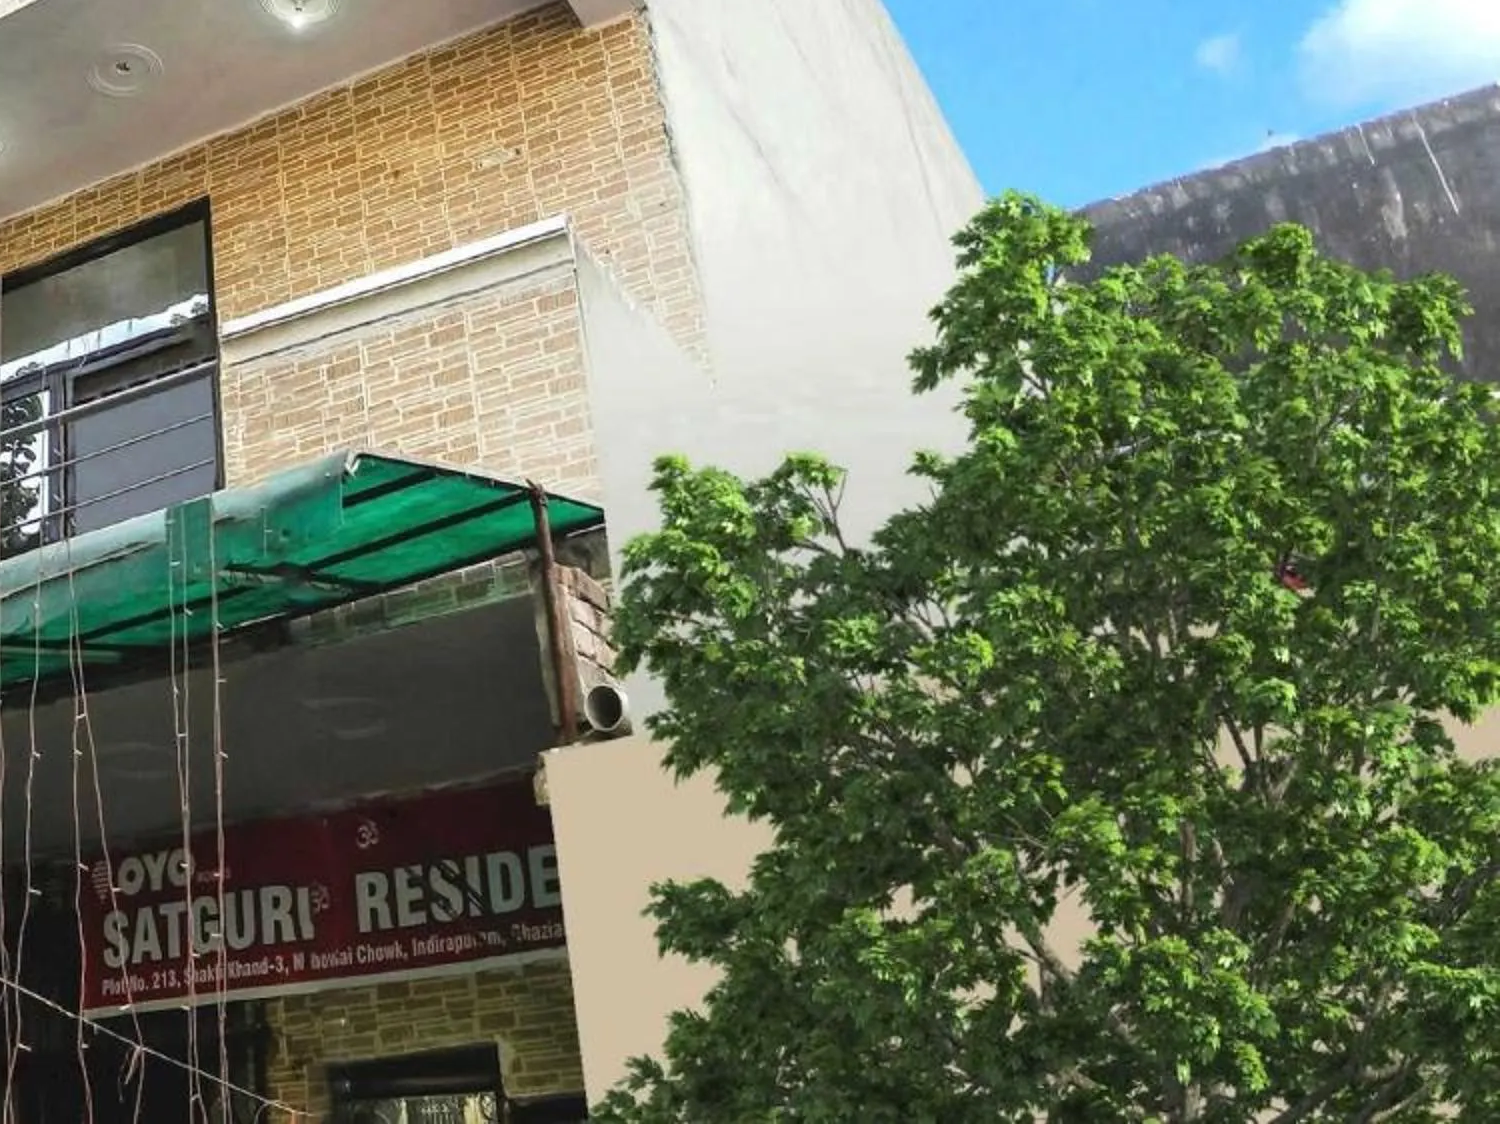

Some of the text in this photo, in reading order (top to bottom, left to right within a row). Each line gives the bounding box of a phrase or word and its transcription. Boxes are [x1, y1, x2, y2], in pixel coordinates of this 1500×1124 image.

[118, 848, 196, 895] OYO
[355, 844, 562, 933] RESIDE
[152, 969, 181, 989] 213,
[357, 941, 408, 964] Chowk,
[412, 930, 507, 957] Indirapum,
